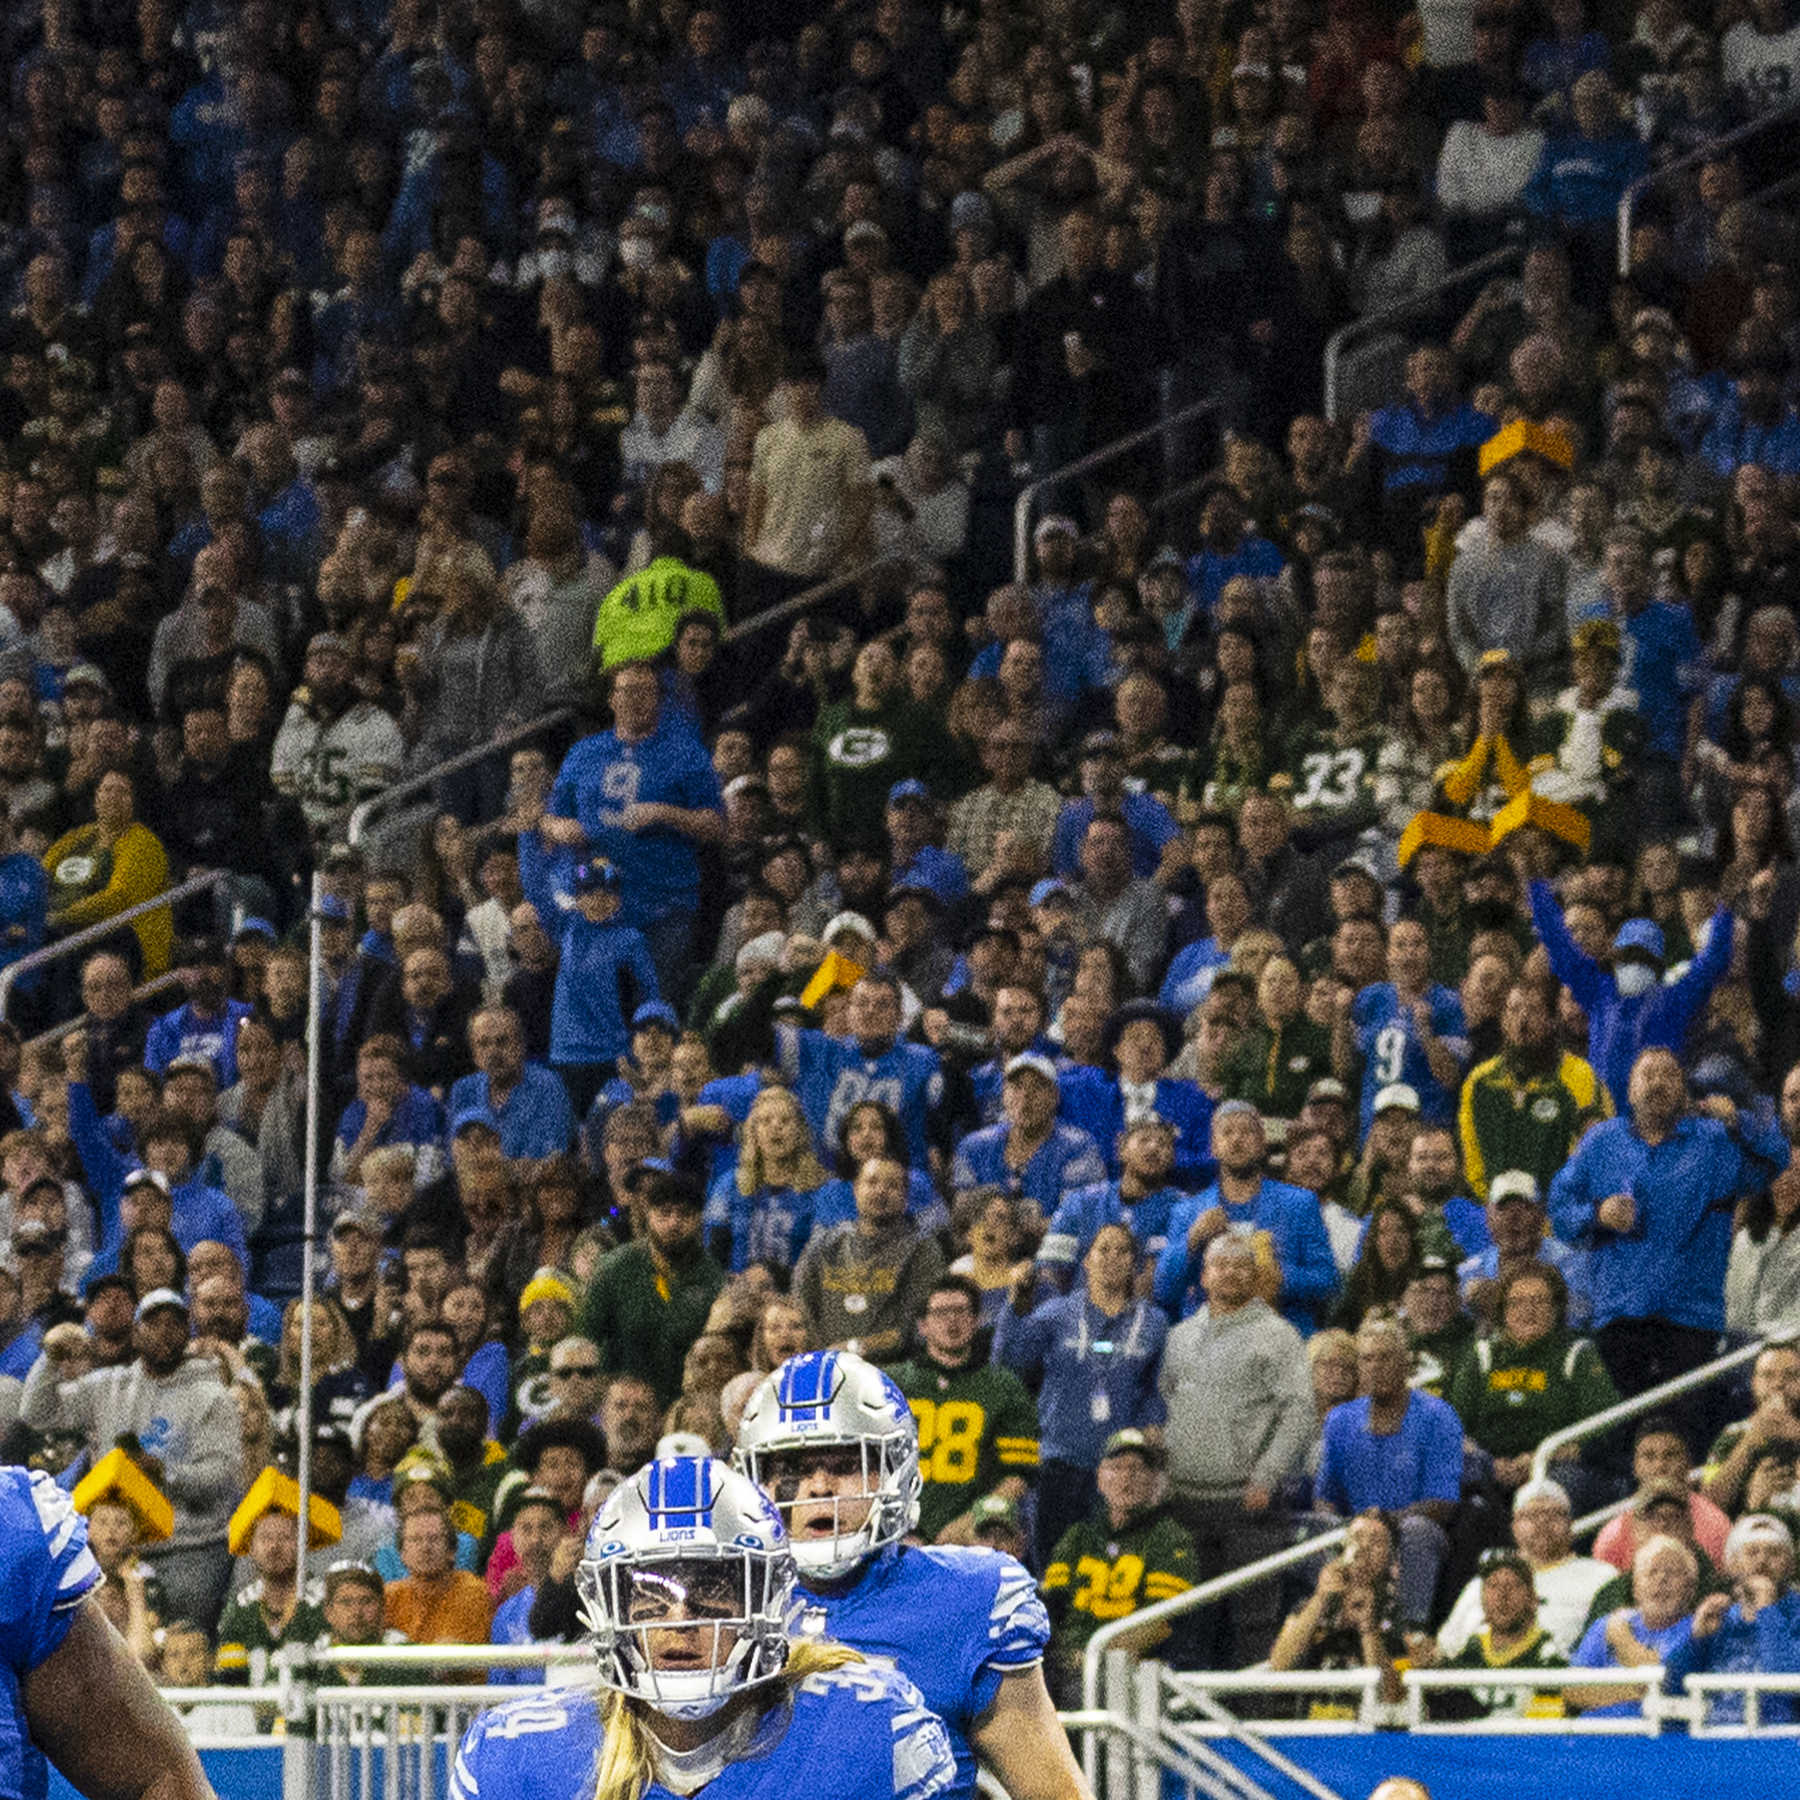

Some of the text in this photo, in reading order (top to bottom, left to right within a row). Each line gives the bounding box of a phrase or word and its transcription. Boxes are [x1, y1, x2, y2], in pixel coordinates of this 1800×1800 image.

[619, 575, 687, 614] 410
[1293, 749, 1365, 808] 33
[1375, 1026, 1406, 1083] 9
[658, 1529, 696, 1543] LIONS
